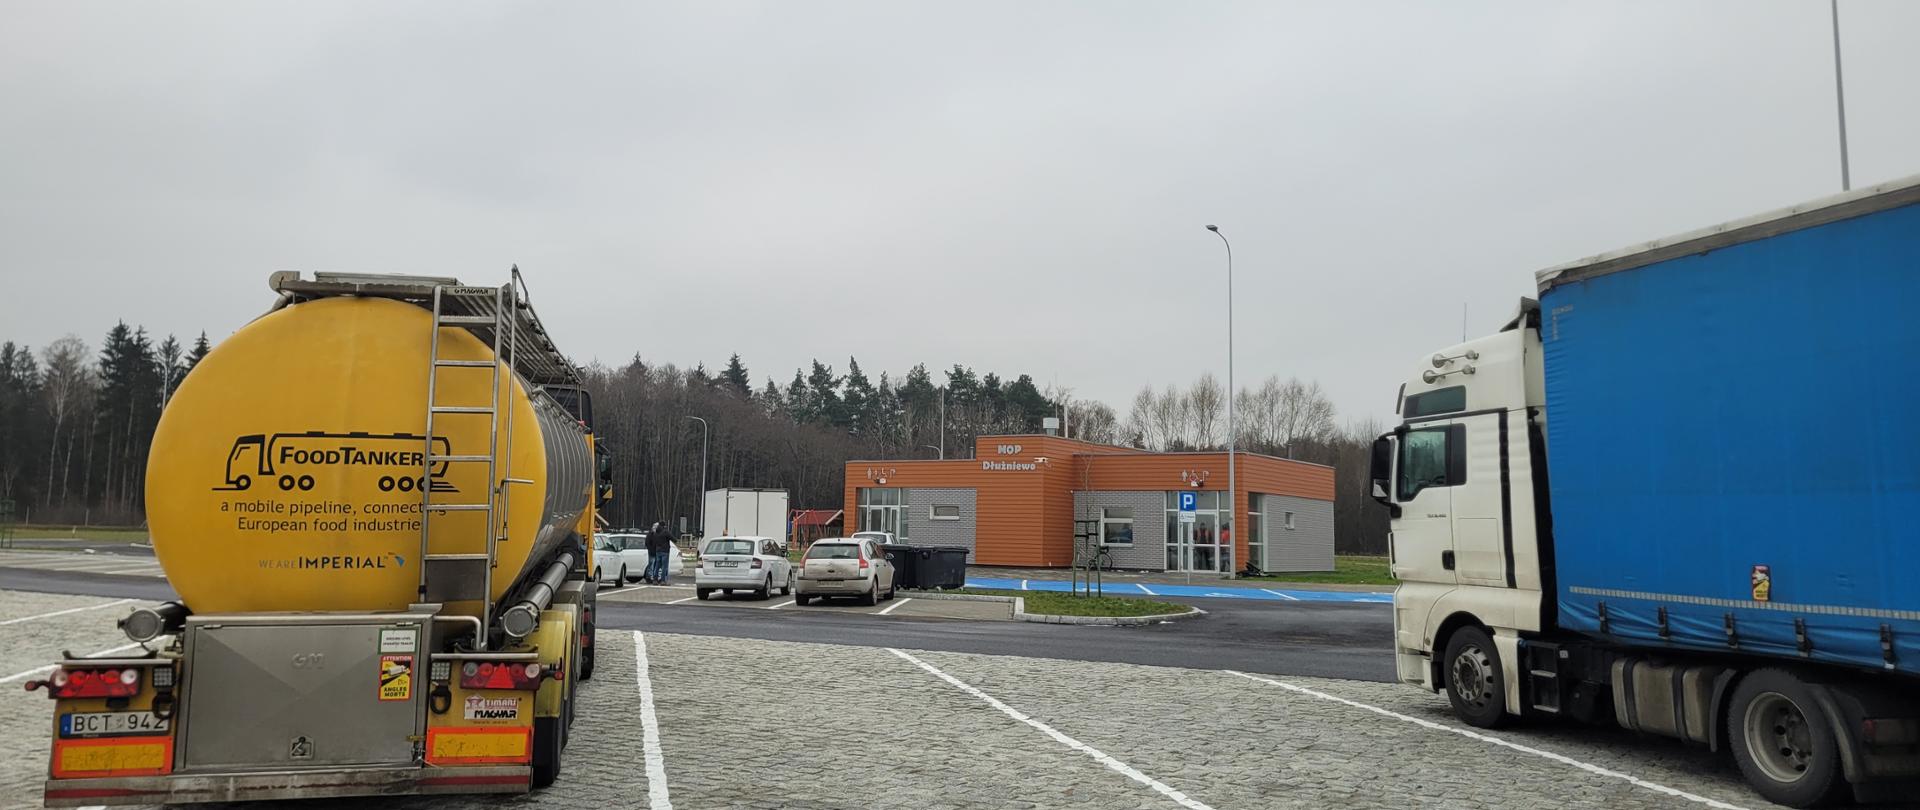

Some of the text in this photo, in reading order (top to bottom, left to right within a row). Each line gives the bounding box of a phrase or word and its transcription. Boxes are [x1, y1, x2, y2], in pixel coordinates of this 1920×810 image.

[998, 445, 1022, 454] MOP
[982, 460, 1036, 471] Dłużniewo
[221, 499, 446, 517] a mobile pipeline, connectg
[1183, 494, 1194, 509] P
[238, 516, 424, 533] European food industrie
[298, 556, 386, 569] IMPERIAL
[474, 709, 517, 718] MAGYAR
[74, 715, 112, 732] BCT
